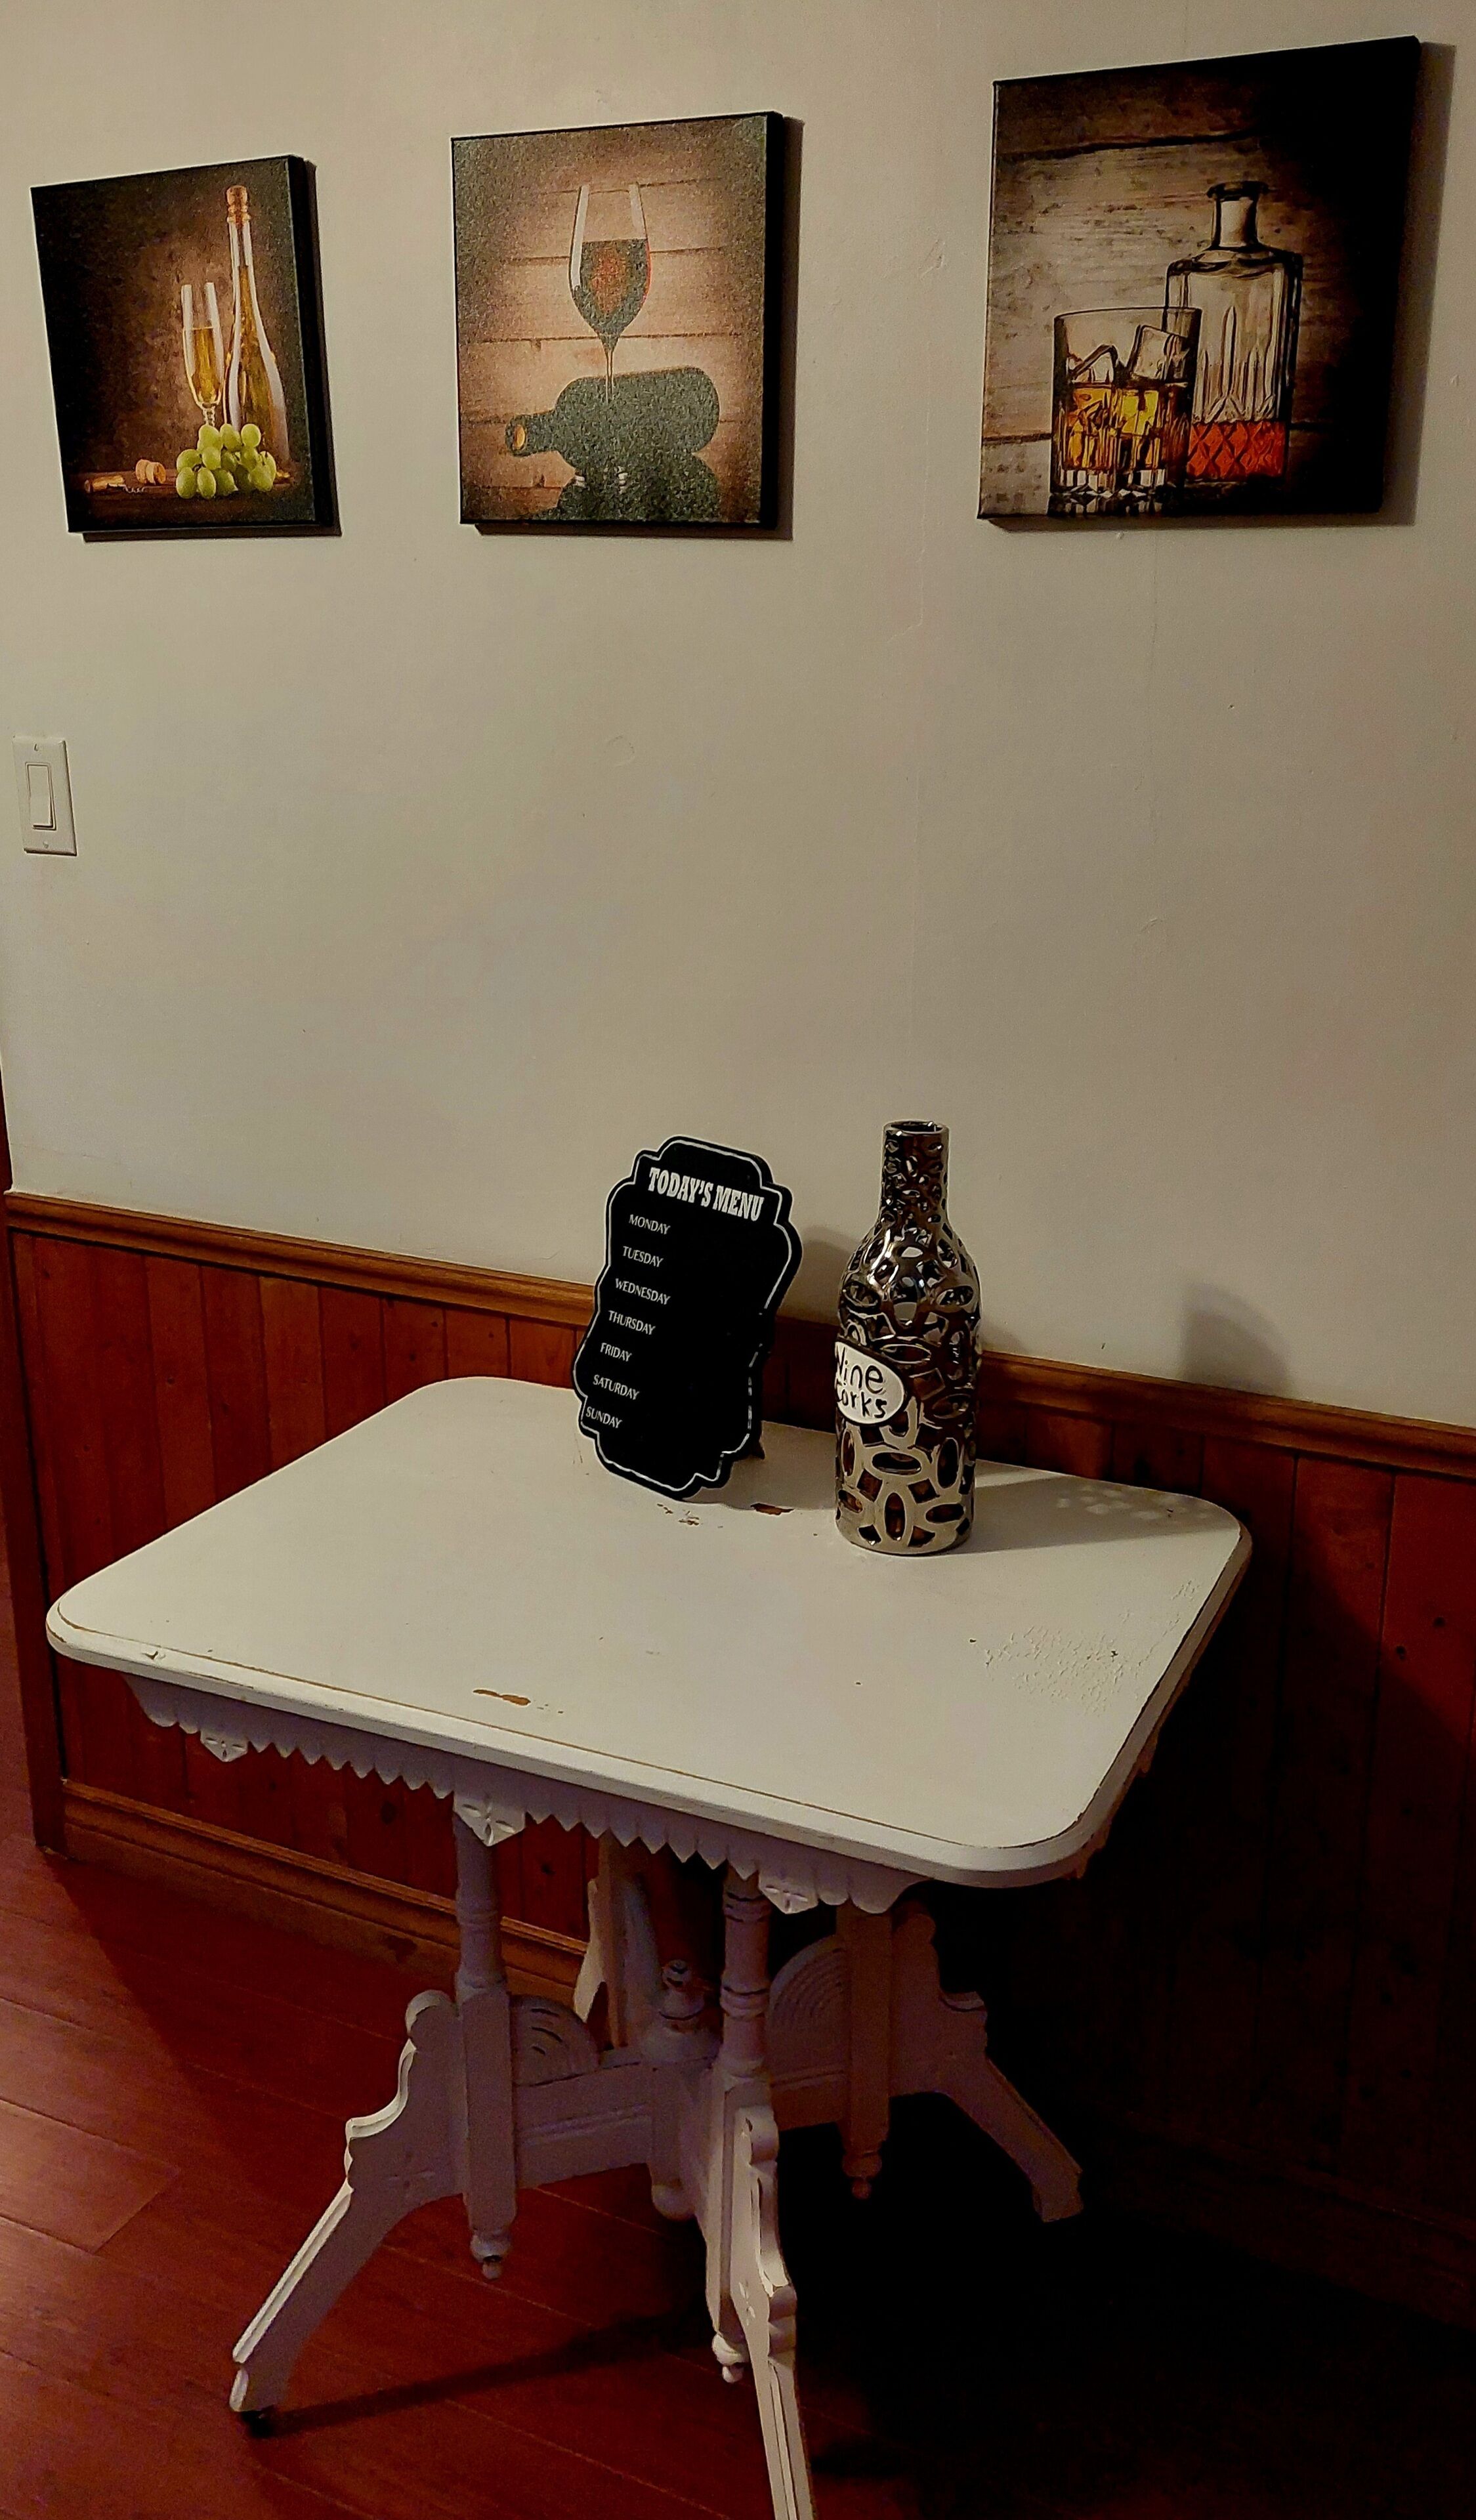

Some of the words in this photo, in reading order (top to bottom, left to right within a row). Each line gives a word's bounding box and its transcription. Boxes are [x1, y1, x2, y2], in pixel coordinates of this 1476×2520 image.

[647, 1166, 713, 1208] TODAY'S
[712, 1185, 765, 1222] MENU
[629, 1213, 671, 1235] MONDAY
[623, 1246, 664, 1268] TUESDAY
[615, 1278, 671, 1305] WEDNESDAY
[608, 1310, 656, 1335] THURSDAY
[600, 1342, 633, 1362] FRIDAY
[593, 1374, 640, 1400] SATURDAY
[585, 1406, 623, 1429] SUNDAY
